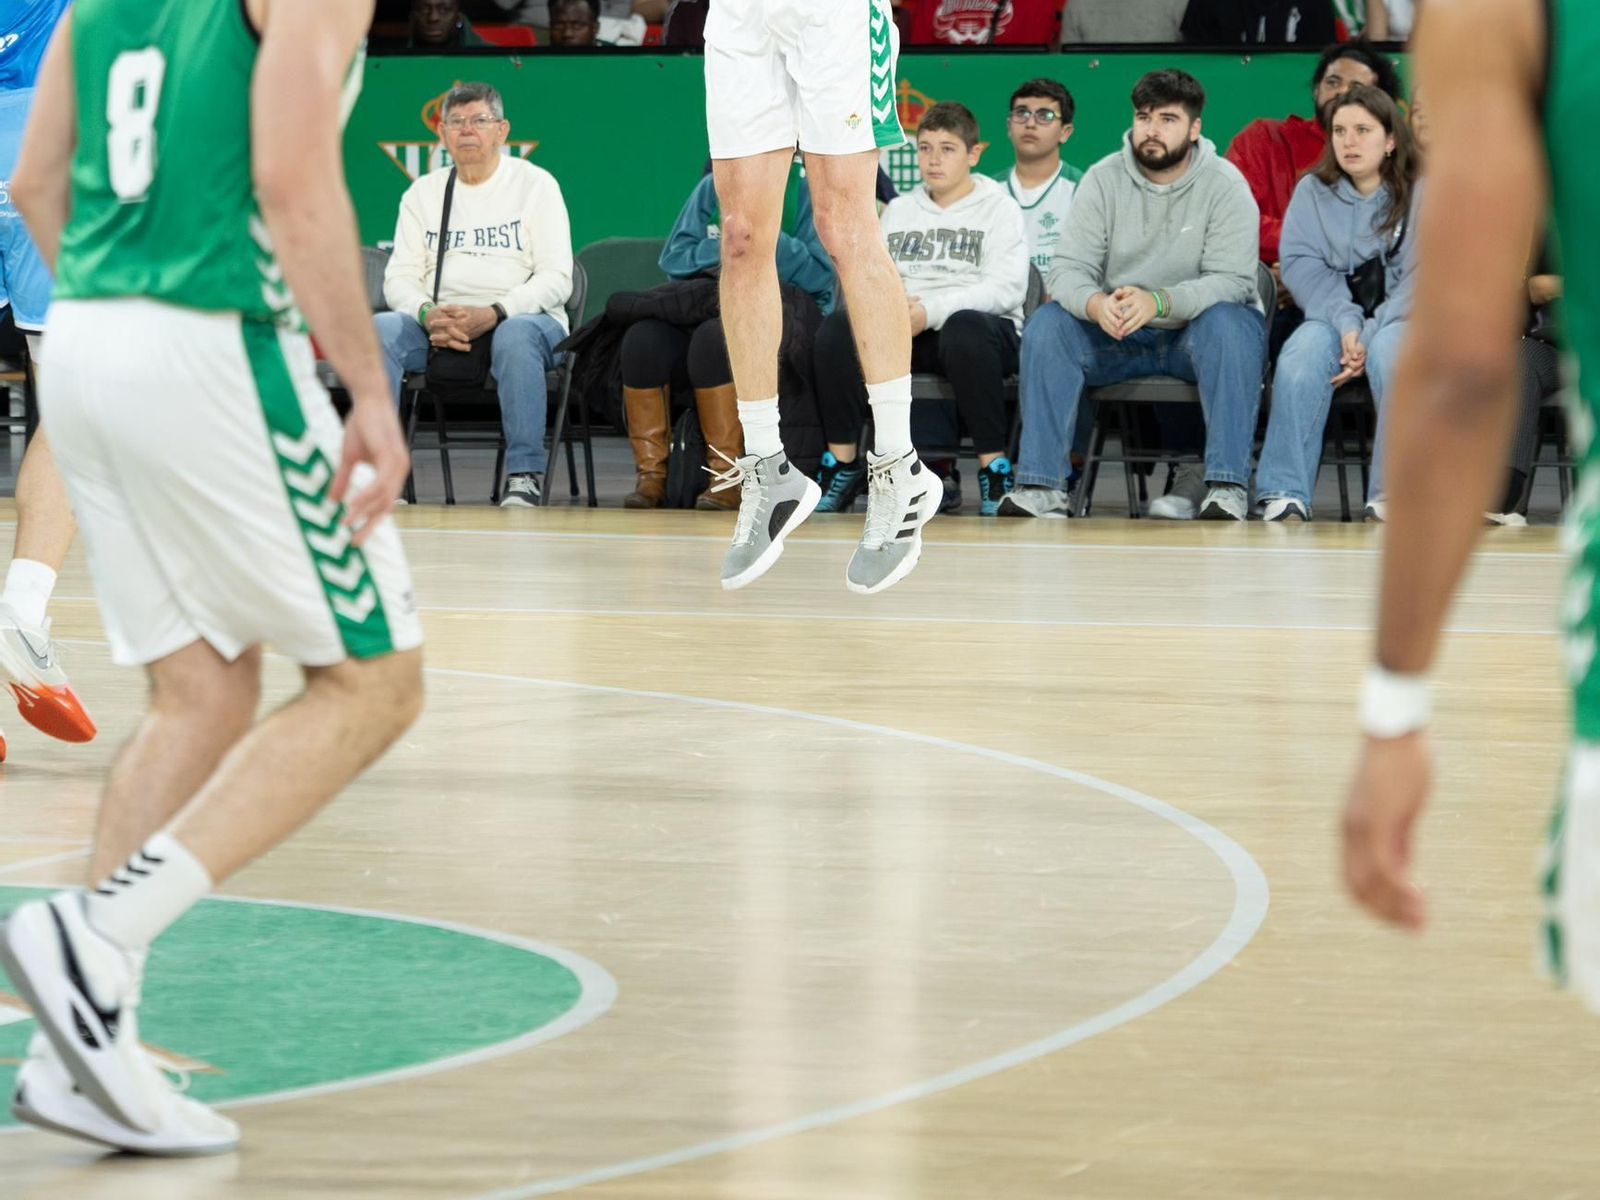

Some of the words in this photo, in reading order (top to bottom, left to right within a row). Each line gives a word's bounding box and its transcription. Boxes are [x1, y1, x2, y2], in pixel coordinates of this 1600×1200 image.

[107, 46, 165, 202] 8
[474, 220, 523, 251] BEST
[888, 228, 985, 267] BOSTON
